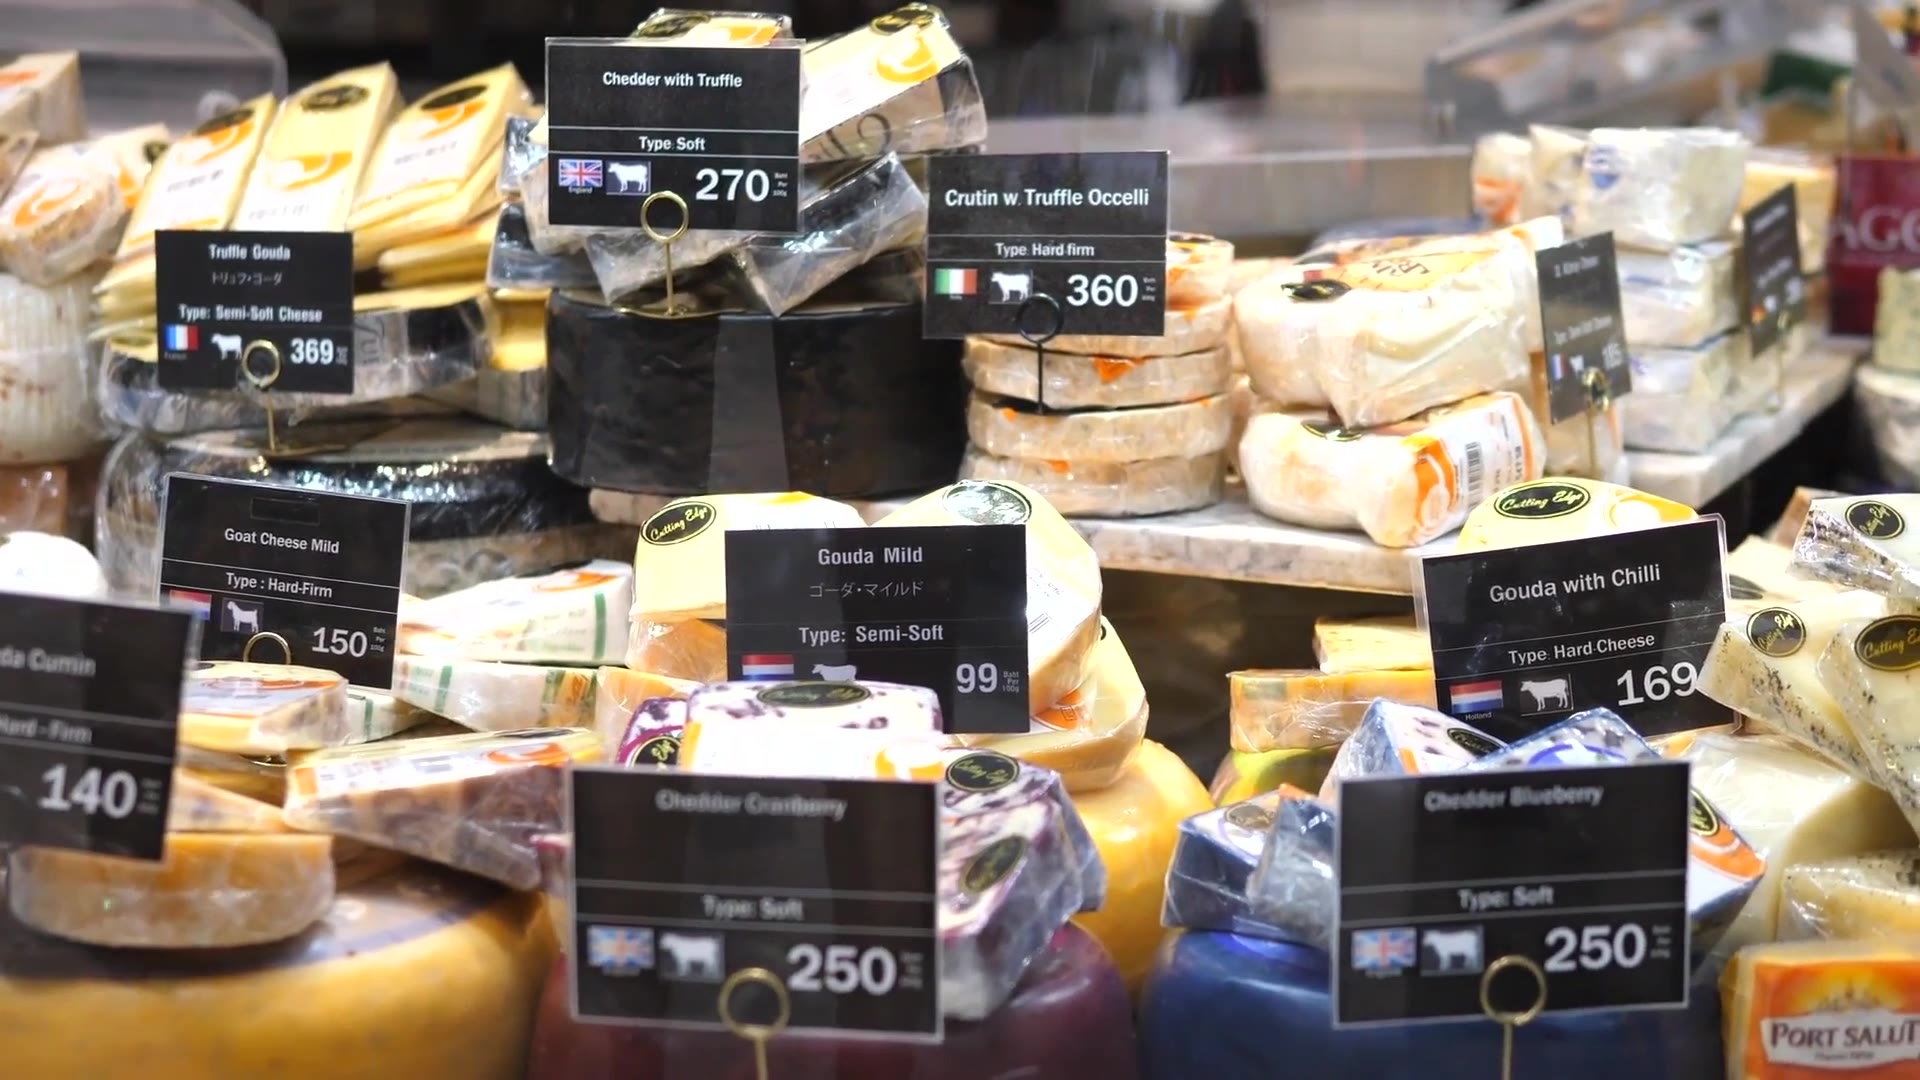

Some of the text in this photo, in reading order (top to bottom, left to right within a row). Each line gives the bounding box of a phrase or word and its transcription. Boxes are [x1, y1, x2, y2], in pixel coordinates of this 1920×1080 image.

[602, 71, 743, 88] Chedder with Truffle
[676, 137, 706, 150] Soft
[695, 167, 770, 202] 270
[945, 188, 998, 206] Crutin
[1024, 188, 1083, 206] Truffle
[1088, 188, 1149, 206] Occelli
[209, 244, 291, 261] Truffle Gouda
[1066, 274, 1139, 307] 360
[179, 304, 323, 322] Type: Semi-Soft Cheese
[290, 337, 334, 365] 369
[1502, 490, 1583, 511] Cutting Edge
[650, 506, 708, 541] Cutting Edge
[224, 527, 340, 554] Goat Cheese Mild
[818, 546, 923, 566] Gouda Mild
[226, 571, 257, 590] Type
[268, 578, 333, 599] Hard-Firm
[810, 580, 924, 598] ゴーダ・マイルド
[1489, 563, 1661, 602] Gouda with Chilli
[312, 626, 368, 658] 150
[799, 624, 944, 647] Type: Semi-Soft
[1863, 639, 1905, 658] Cutting
[28, 647, 96, 677] Cumin
[956, 662, 998, 694] 99
[1002, 684, 1020, 694] 100g
[1007, 678, 1020, 686] Per
[1616, 661, 1699, 706] 169
[1464, 711, 1493, 721] Holland
[39, 764, 137, 819] 140
[655, 788, 847, 821] Chedder Cranberry
[1423, 784, 1604, 812] Chedder Blueberry
[703, 894, 804, 921] Type: Soft
[1458, 885, 1555, 912] Type: Soft
[1544, 923, 1648, 973] 250
[787, 943, 897, 995] 250
[1771, 1019, 1920, 1048] PORT SALUT
